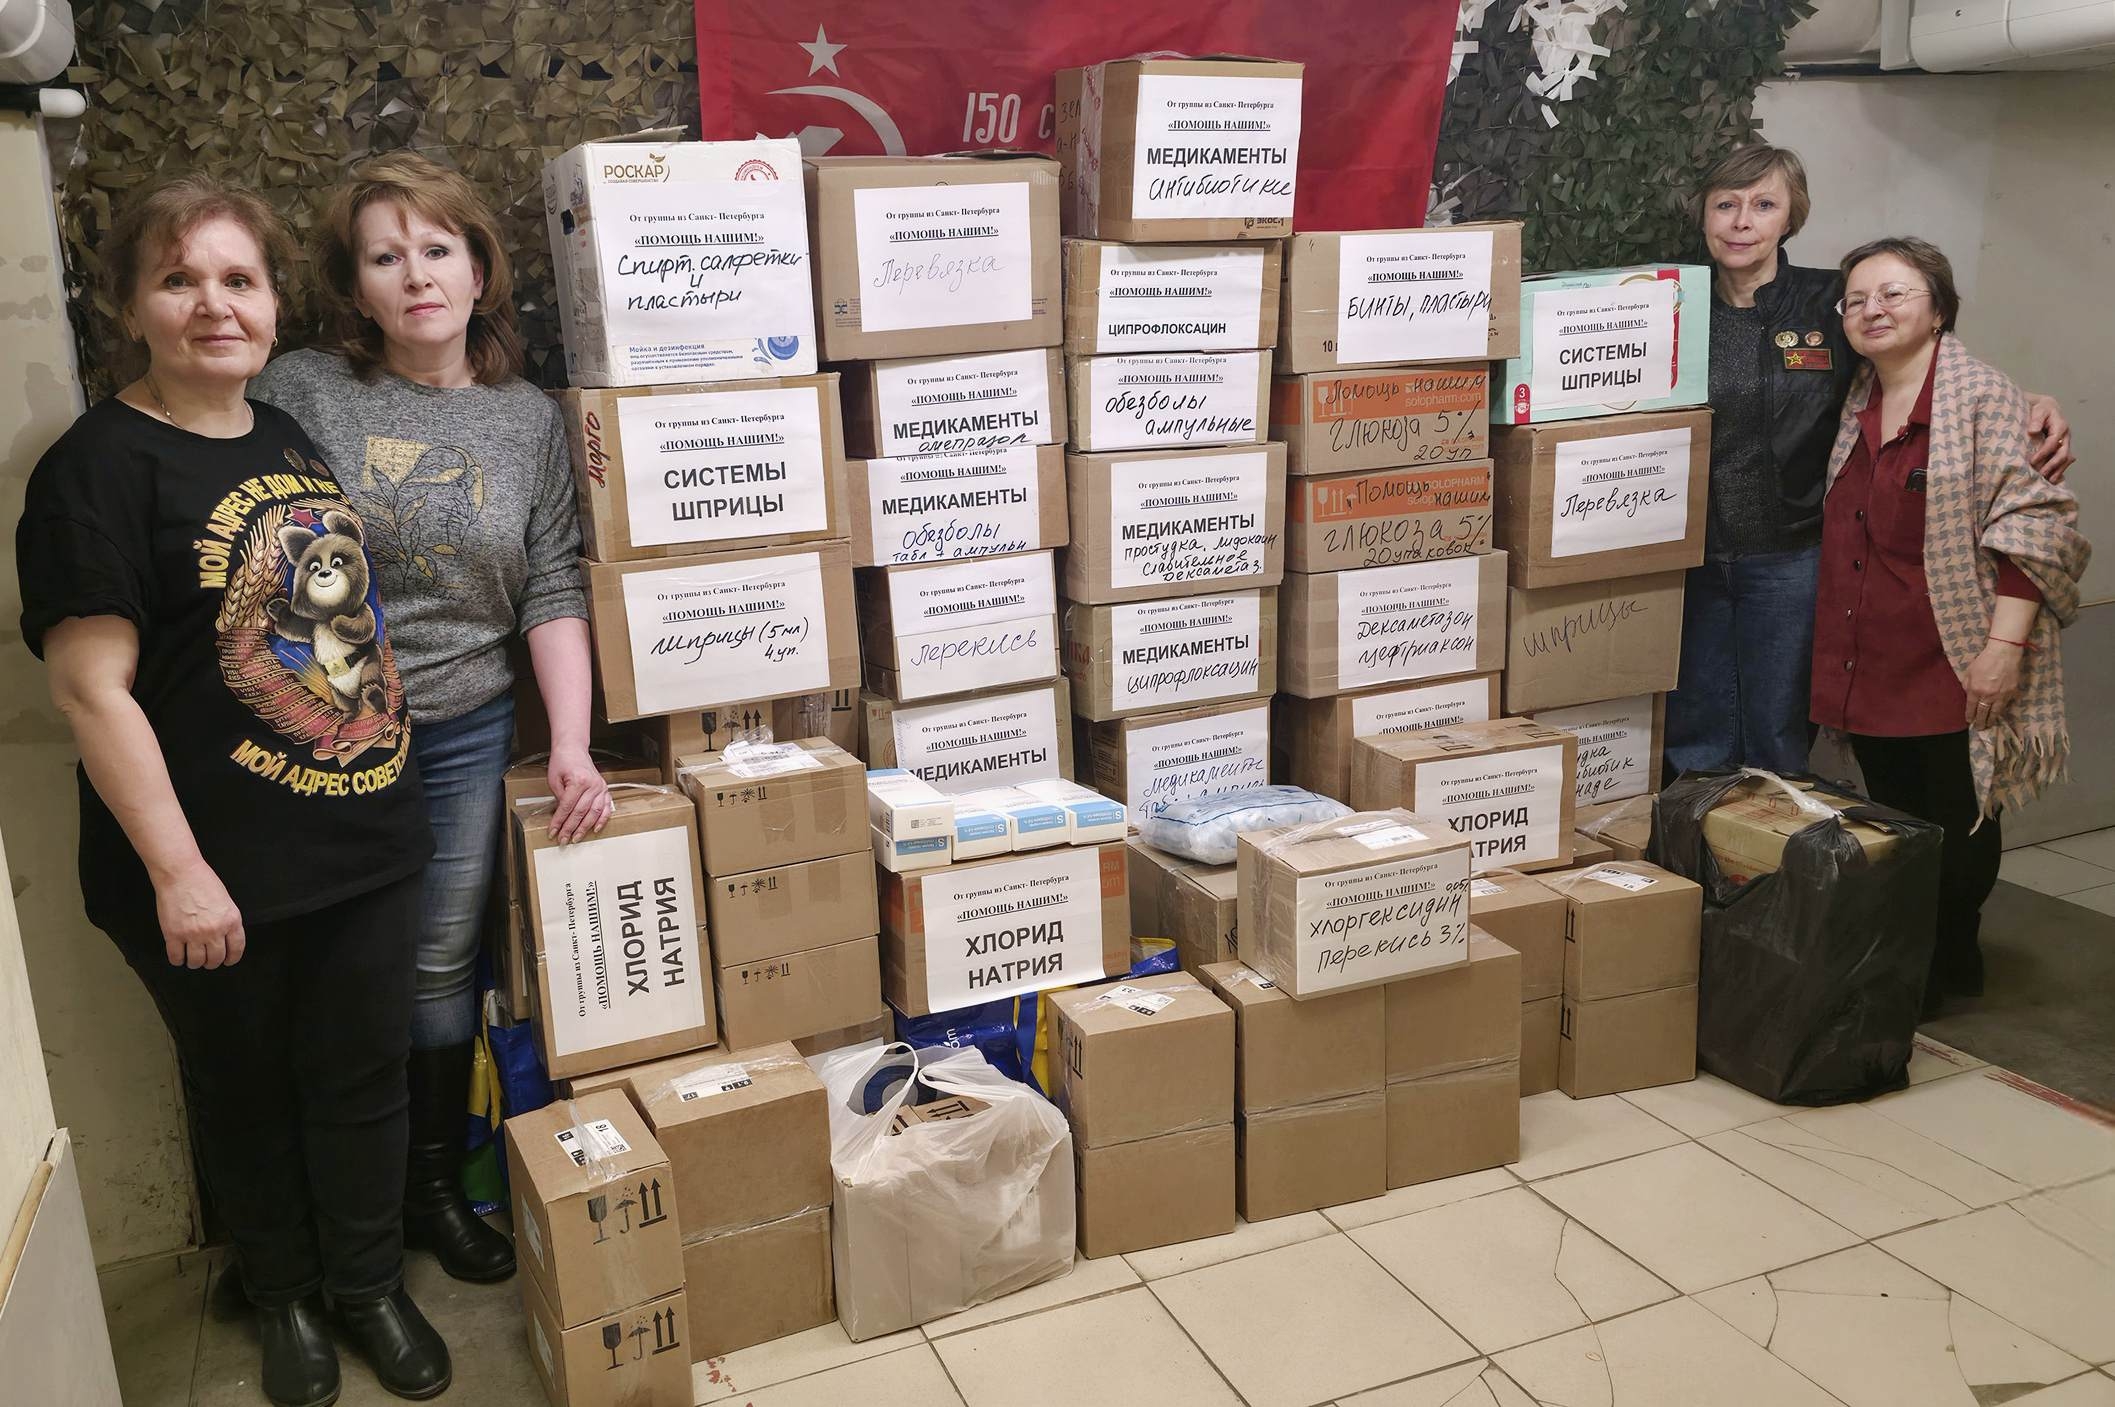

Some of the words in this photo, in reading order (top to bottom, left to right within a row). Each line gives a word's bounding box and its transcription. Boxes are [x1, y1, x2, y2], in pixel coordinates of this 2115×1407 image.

[962, 92, 1022, 143] 150
[1178, 102, 1203, 110] группы
[1237, 101, 1274, 110] Петербурга
[1168, 121, 1221, 131] «ПОМОЩЬ
[1224, 120, 1271, 131] НАШИМ!»
[1147, 147, 1286, 168] МЕДИКАМЕНТЫ
[604, 165, 665, 179] РОСКАР
[634, 234, 701, 247] «ПОМОЩЬ
[704, 233, 765, 245] НАШИМ!»
[889, 229, 946, 242] «ПОМОЩЬ
[948, 226, 1000, 238] НАШИМ!»
[700, 248, 803, 276] салфетки
[690, 273, 704, 289] и
[1367, 272, 1417, 283] «ПОМОЩЬ
[1419, 270, 1464, 281] НАШИМ!»
[627, 290, 742, 310] пластыри
[1109, 287, 1163, 298] «ПОМОЩЬ
[1165, 287, 1213, 297] НАШИМ!»
[1108, 323, 1226, 337] ЦИПРОФЛОКСАЦИН
[1559, 324, 1606, 336] «ПОМОЩЬ
[1607, 319, 1648, 332] НАШИМ!»
[629, 345, 652, 353] Мойка
[660, 344, 705, 353] дезинфекция
[1322, 340, 1333, 353] 10
[1559, 342, 1647, 365] СИСТЕМЫ
[1118, 374, 1172, 386] «ПОМОЩЬ
[1174, 373, 1225, 385] НАШИМ!»
[1561, 368, 1641, 391] ШПРИЦЫ
[911, 392, 966, 406] «ПОМОЩЬ
[968, 387, 1018, 400] НАШИМ!»
[1519, 387, 1526, 399] 3
[893, 410, 1039, 439] МЕДИКАМЕНТЫ
[1144, 415, 1255, 440] ампульные
[659, 437, 724, 453] «ПОМОЩЬ
[726, 432, 786, 447] НАШИМ!»
[919, 432, 1033, 453] омепразол
[663, 460, 787, 489] СИСТЕМЫ
[900, 469, 955, 483] «ПОМОЩЬ
[956, 464, 1007, 477] НАШИМ!»
[1581, 473, 1626, 486] «ПОМОЩЬ
[1626, 466, 1666, 480] НАШИМ!»
[238, 477, 272, 503] НЕ
[260, 473, 306, 500] ДОМ
[672, 493, 785, 521] ШПРИЦЫ
[882, 487, 1027, 515] МЕДИКАМЕНТЫ
[1140, 496, 1191, 510] «ПОМОЩЬ
[1192, 492, 1239, 504] НАШИМ!»
[1560, 487, 1677, 521] Перевязка
[204, 491, 257, 542] АДРЕС
[1122, 513, 1255, 540] МЕДИКАМЕНТЫ
[192, 539, 232, 589] МОЙ
[662, 607, 726, 623] «ПОМОЩЬ
[728, 599, 787, 615] НАШИМ!»
[923, 601, 976, 618] «ПОМОЩЬ
[978, 594, 1026, 611] НАШИМ!»
[1139, 620, 1188, 636] «ПОМОЩЬ
[1189, 614, 1234, 629] НАШИМ!»
[1122, 634, 1249, 665] МЕДИКАМЕНТЫ
[1126, 657, 1259, 694] ципрофлоксацин
[926, 736, 978, 753] «ПОМОЩЬ
[979, 728, 1028, 744] НАШИМ!»
[229, 737, 289, 780] МОЙ
[280, 763, 351, 798] АДРЕС
[909, 747, 1047, 782] МЕДИКАМЕНТЫ
[1153, 754, 1200, 771] «ПОМОЩЬ
[1201, 746, 1243, 762] НАШИМ!»
[1442, 789, 1491, 805] «ПОМОЩЬ
[1491, 783, 1536, 800] НАШИМ!»
[1448, 806, 1529, 833] ХЛОРИД
[1470, 834, 1527, 859] ТРИЯ
[953, 892, 964, 901] От
[965, 888, 993, 901] группы
[1003, 883, 1028, 893] Санкт-
[1029, 875, 1070, 889] Петербурга
[1326, 890, 1384, 909] «ПОМОЩЬ
[1385, 881, 1437, 899] НАШИМ!»
[586, 880, 602, 943] НАШИМ!»
[957, 903, 1015, 922] «ПОМОЩЬ
[1016, 892, 1070, 911] НАШИМ!»
[617, 879, 651, 997] ХЛОРИД
[653, 877, 686, 988] НАТРИЯ
[965, 920, 1064, 958] ХЛОРИД
[592, 944, 611, 1010] «ПОМОЩЬ
[968, 952, 1064, 990] НАТРИЯ
